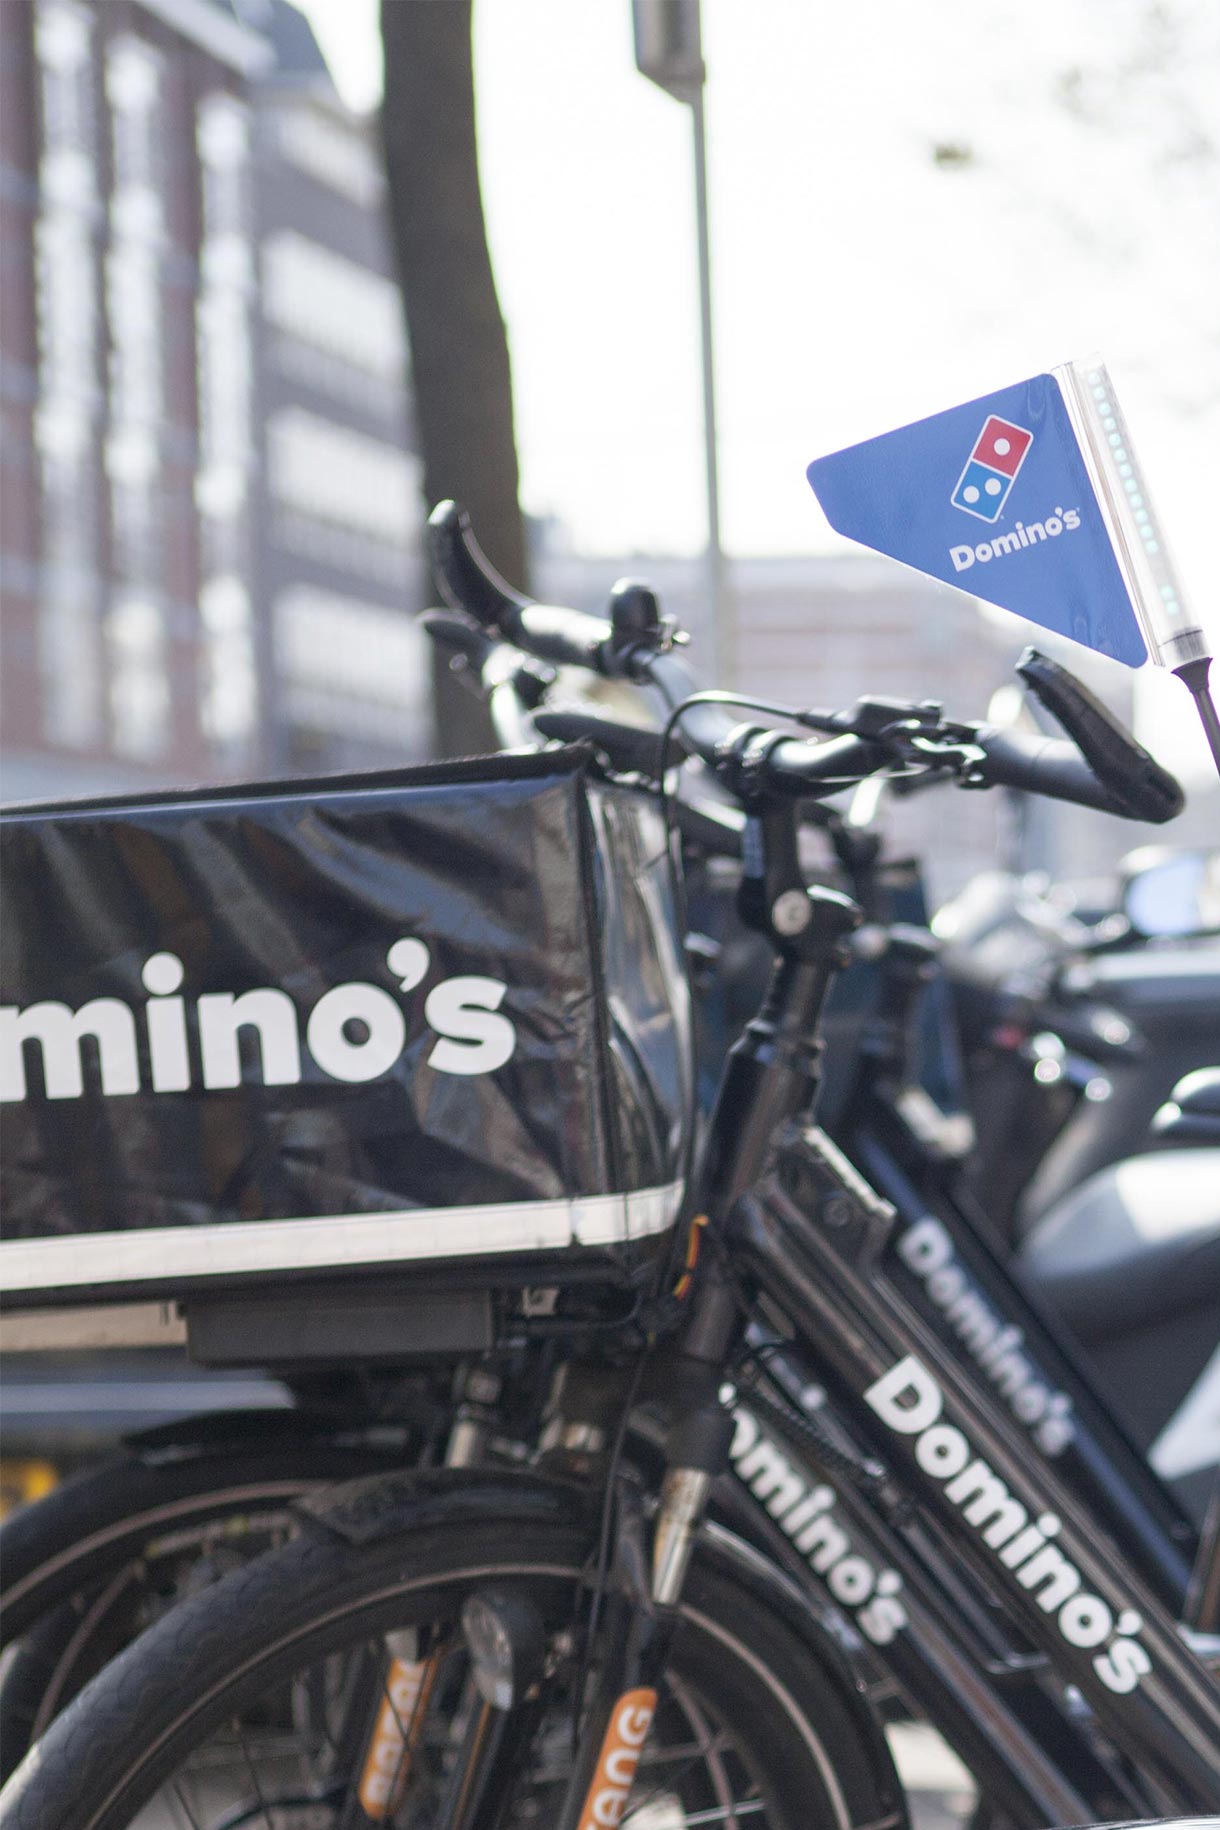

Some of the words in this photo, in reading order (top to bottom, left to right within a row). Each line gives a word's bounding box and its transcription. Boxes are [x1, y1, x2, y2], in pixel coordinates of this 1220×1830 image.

[949, 506, 1081, 572] Domino's
[900, 1214, 1077, 1457] Domino's
[863, 1354, 1153, 1694] Domino's
